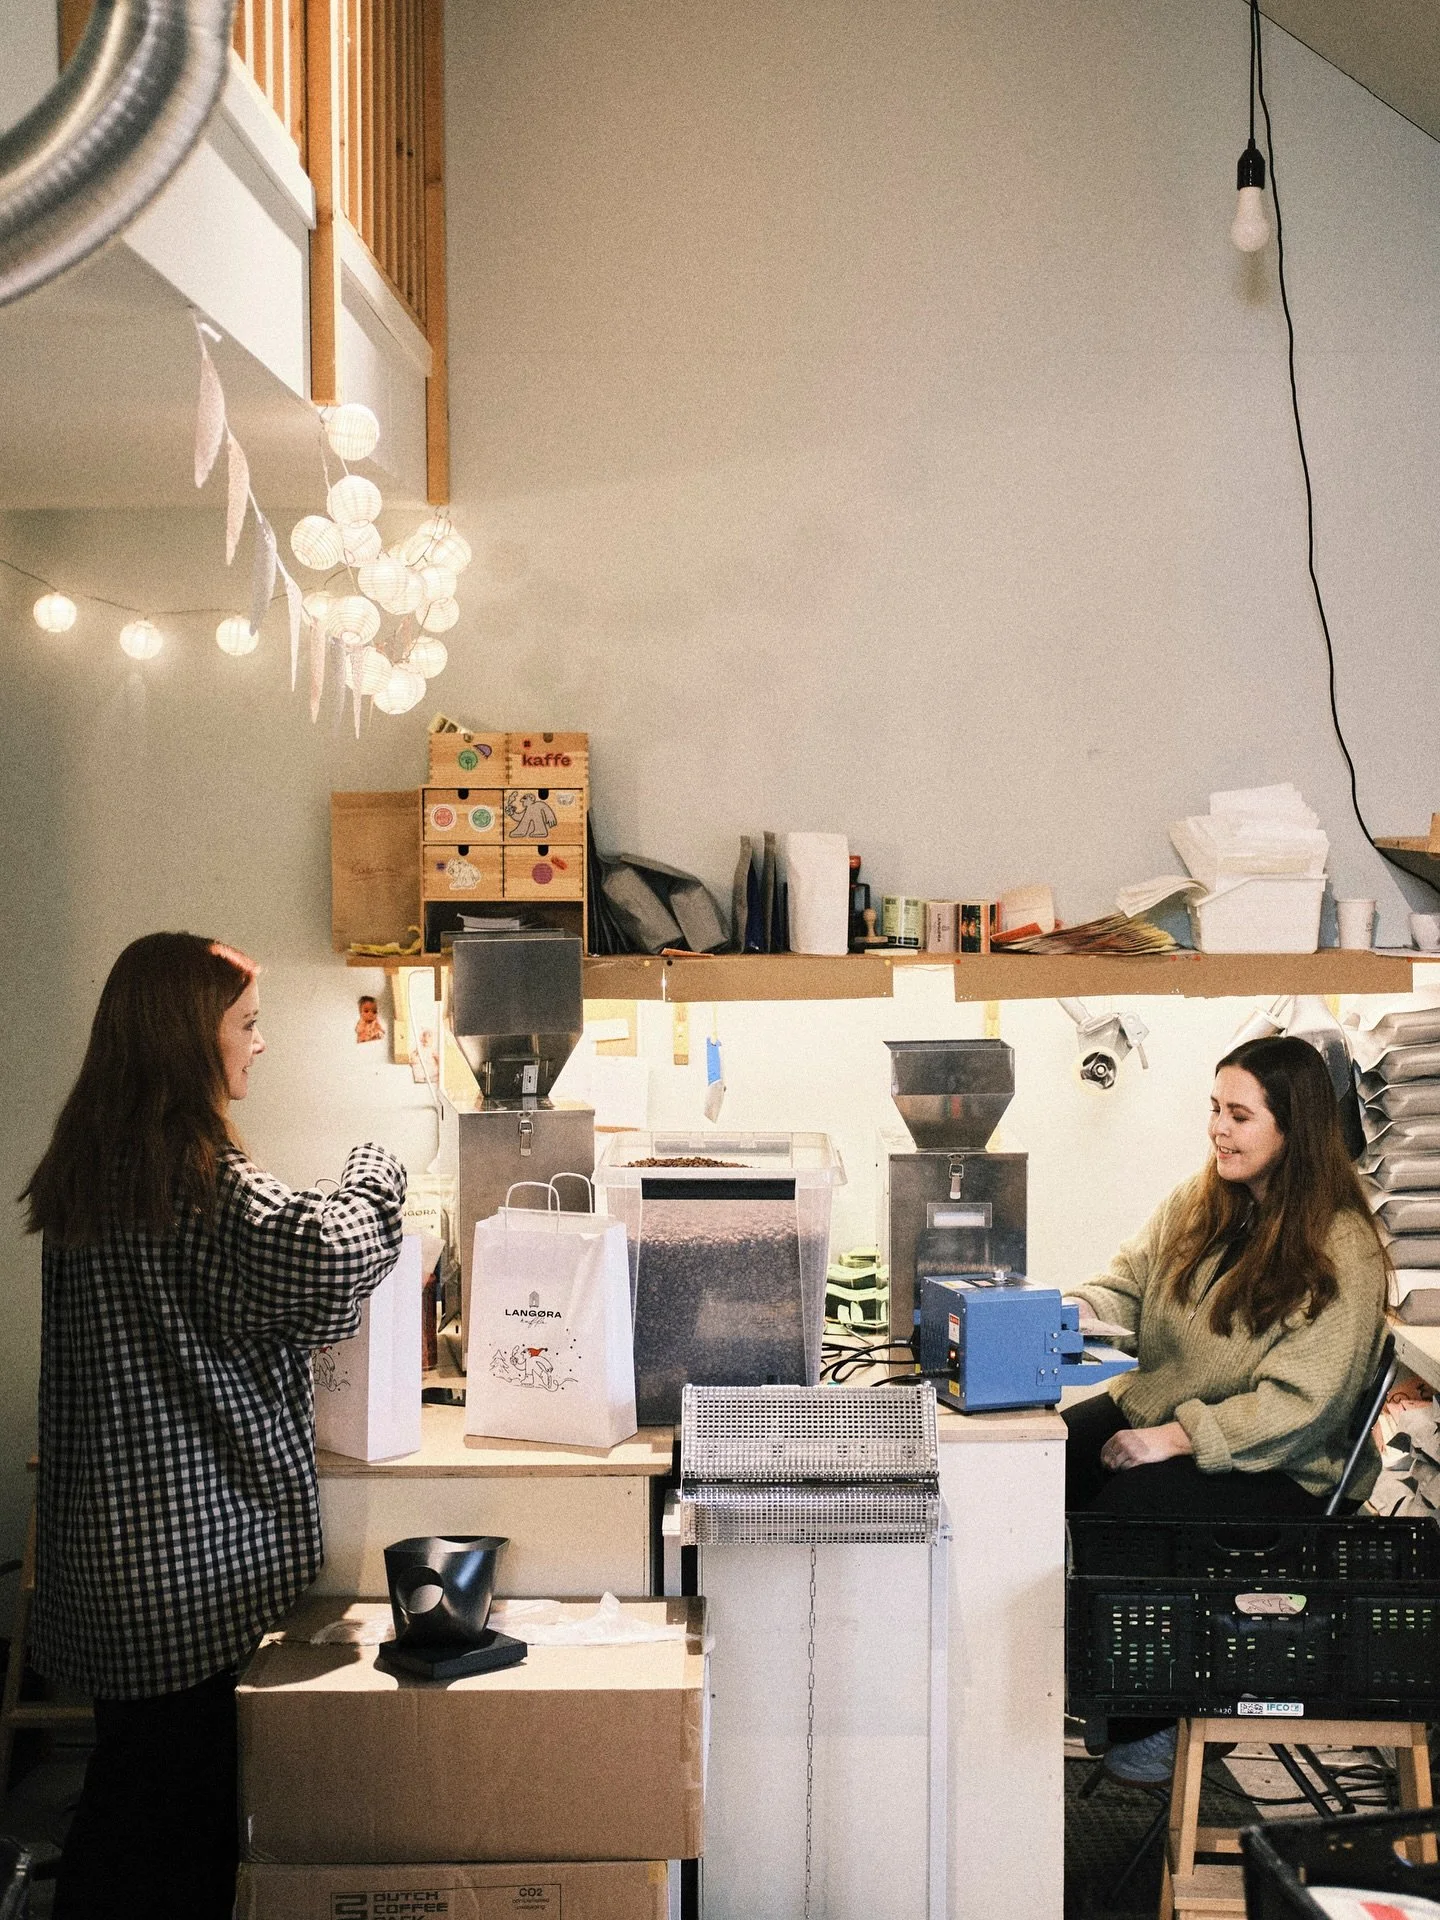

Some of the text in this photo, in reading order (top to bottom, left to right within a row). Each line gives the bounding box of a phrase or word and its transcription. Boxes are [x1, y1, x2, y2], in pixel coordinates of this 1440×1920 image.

[522, 753, 571, 767] kaffe
[505, 1309, 562, 1318] LANGØRA
[1266, 1703, 1289, 1711] IFCO
[374, 1891, 438, 1902] DUTCH
[519, 1887, 543, 1897] CO2
[374, 1903, 448, 1914] COFFEE
